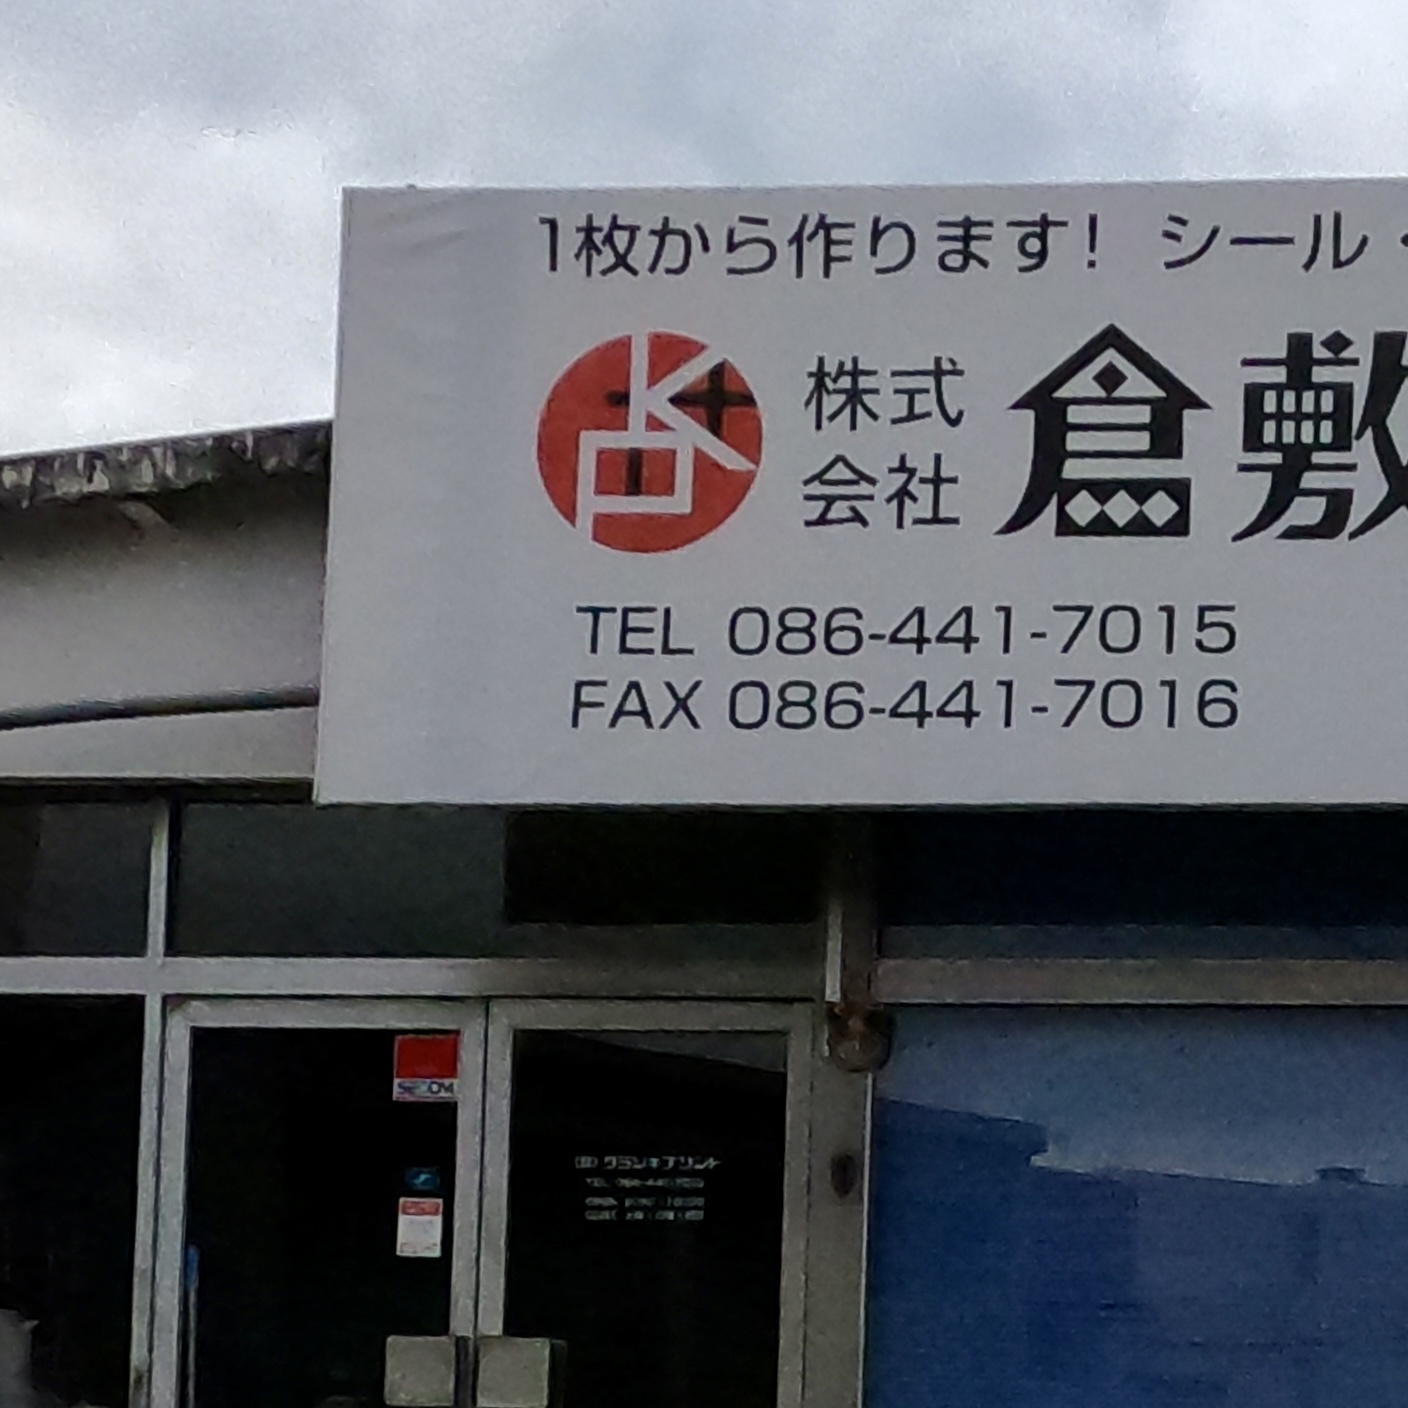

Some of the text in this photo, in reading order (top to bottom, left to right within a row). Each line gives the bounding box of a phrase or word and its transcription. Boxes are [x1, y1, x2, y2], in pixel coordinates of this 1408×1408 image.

[539, 212, 1098, 279] 1枚から作ります!
[804, 355, 965, 432] 株式
[802, 452, 960, 530] 会社
[575, 604, 1237, 656] TEL 086-441-7015
[571, 678, 1239, 731] FAX 086-441-7016
